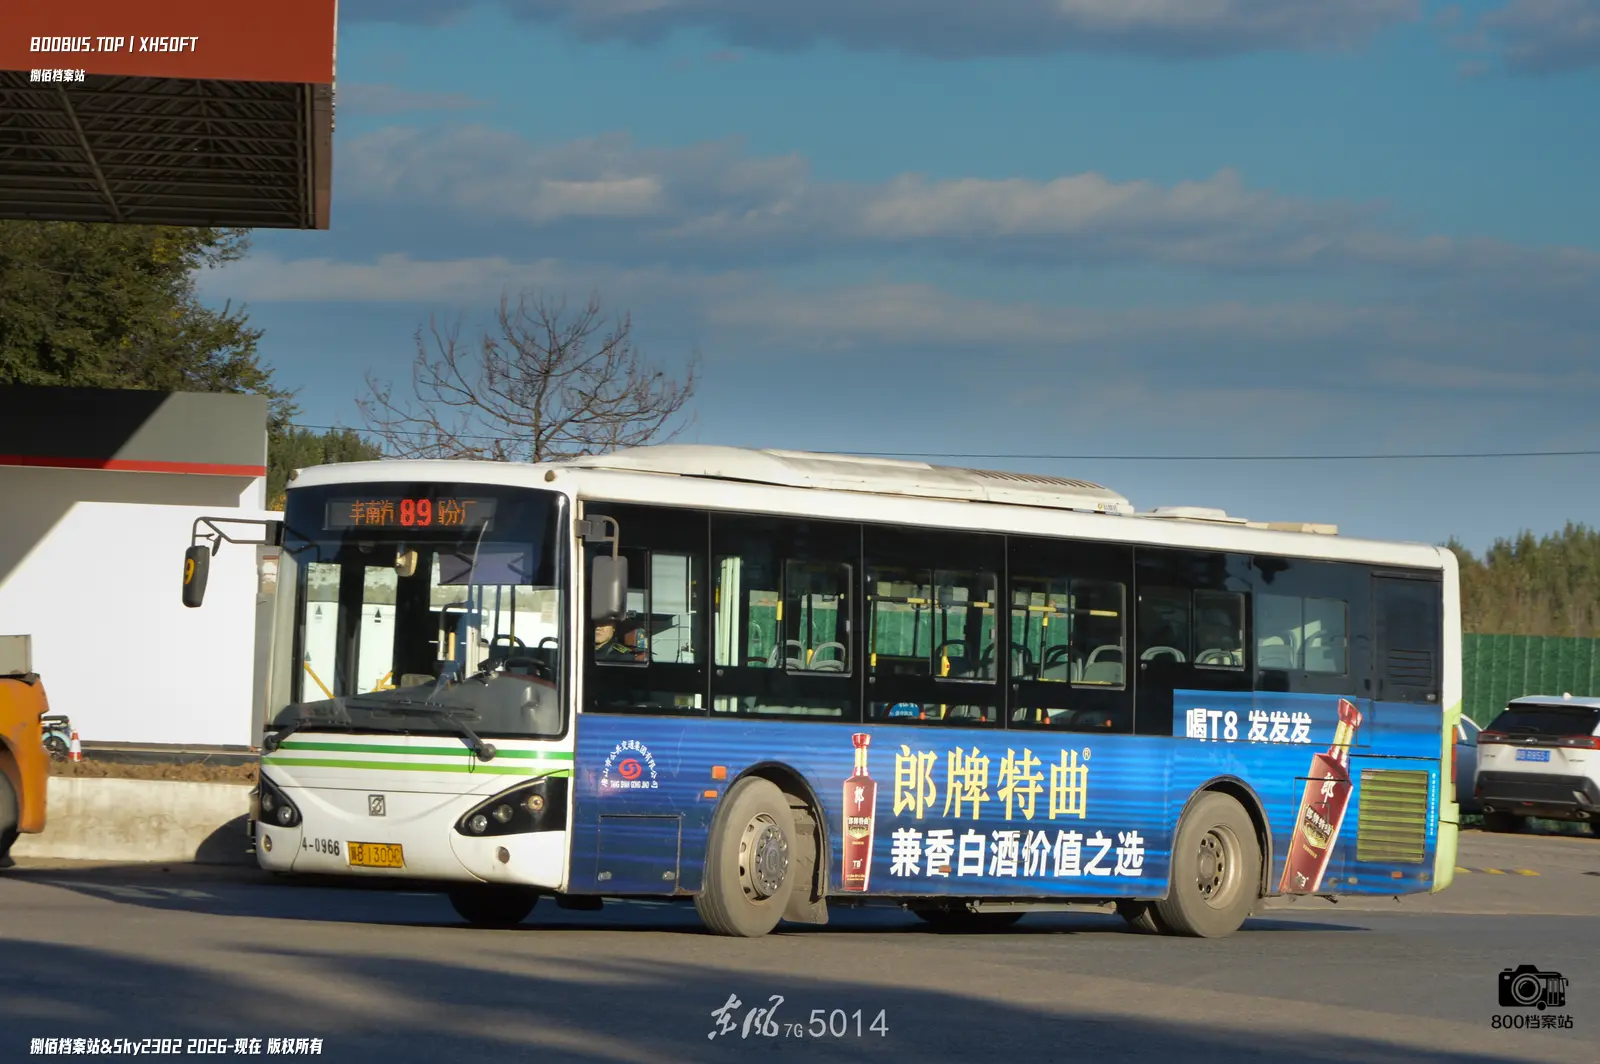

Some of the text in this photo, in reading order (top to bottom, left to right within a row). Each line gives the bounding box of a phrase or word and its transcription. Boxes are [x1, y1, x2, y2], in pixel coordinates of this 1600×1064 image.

[400, 498, 432, 526] 89
[1186, 708, 1312, 743] 喝T8 发发发
[301, 836, 341, 857] 4-0966
[889, 827, 1146, 878] 兼香白酒价值之选
